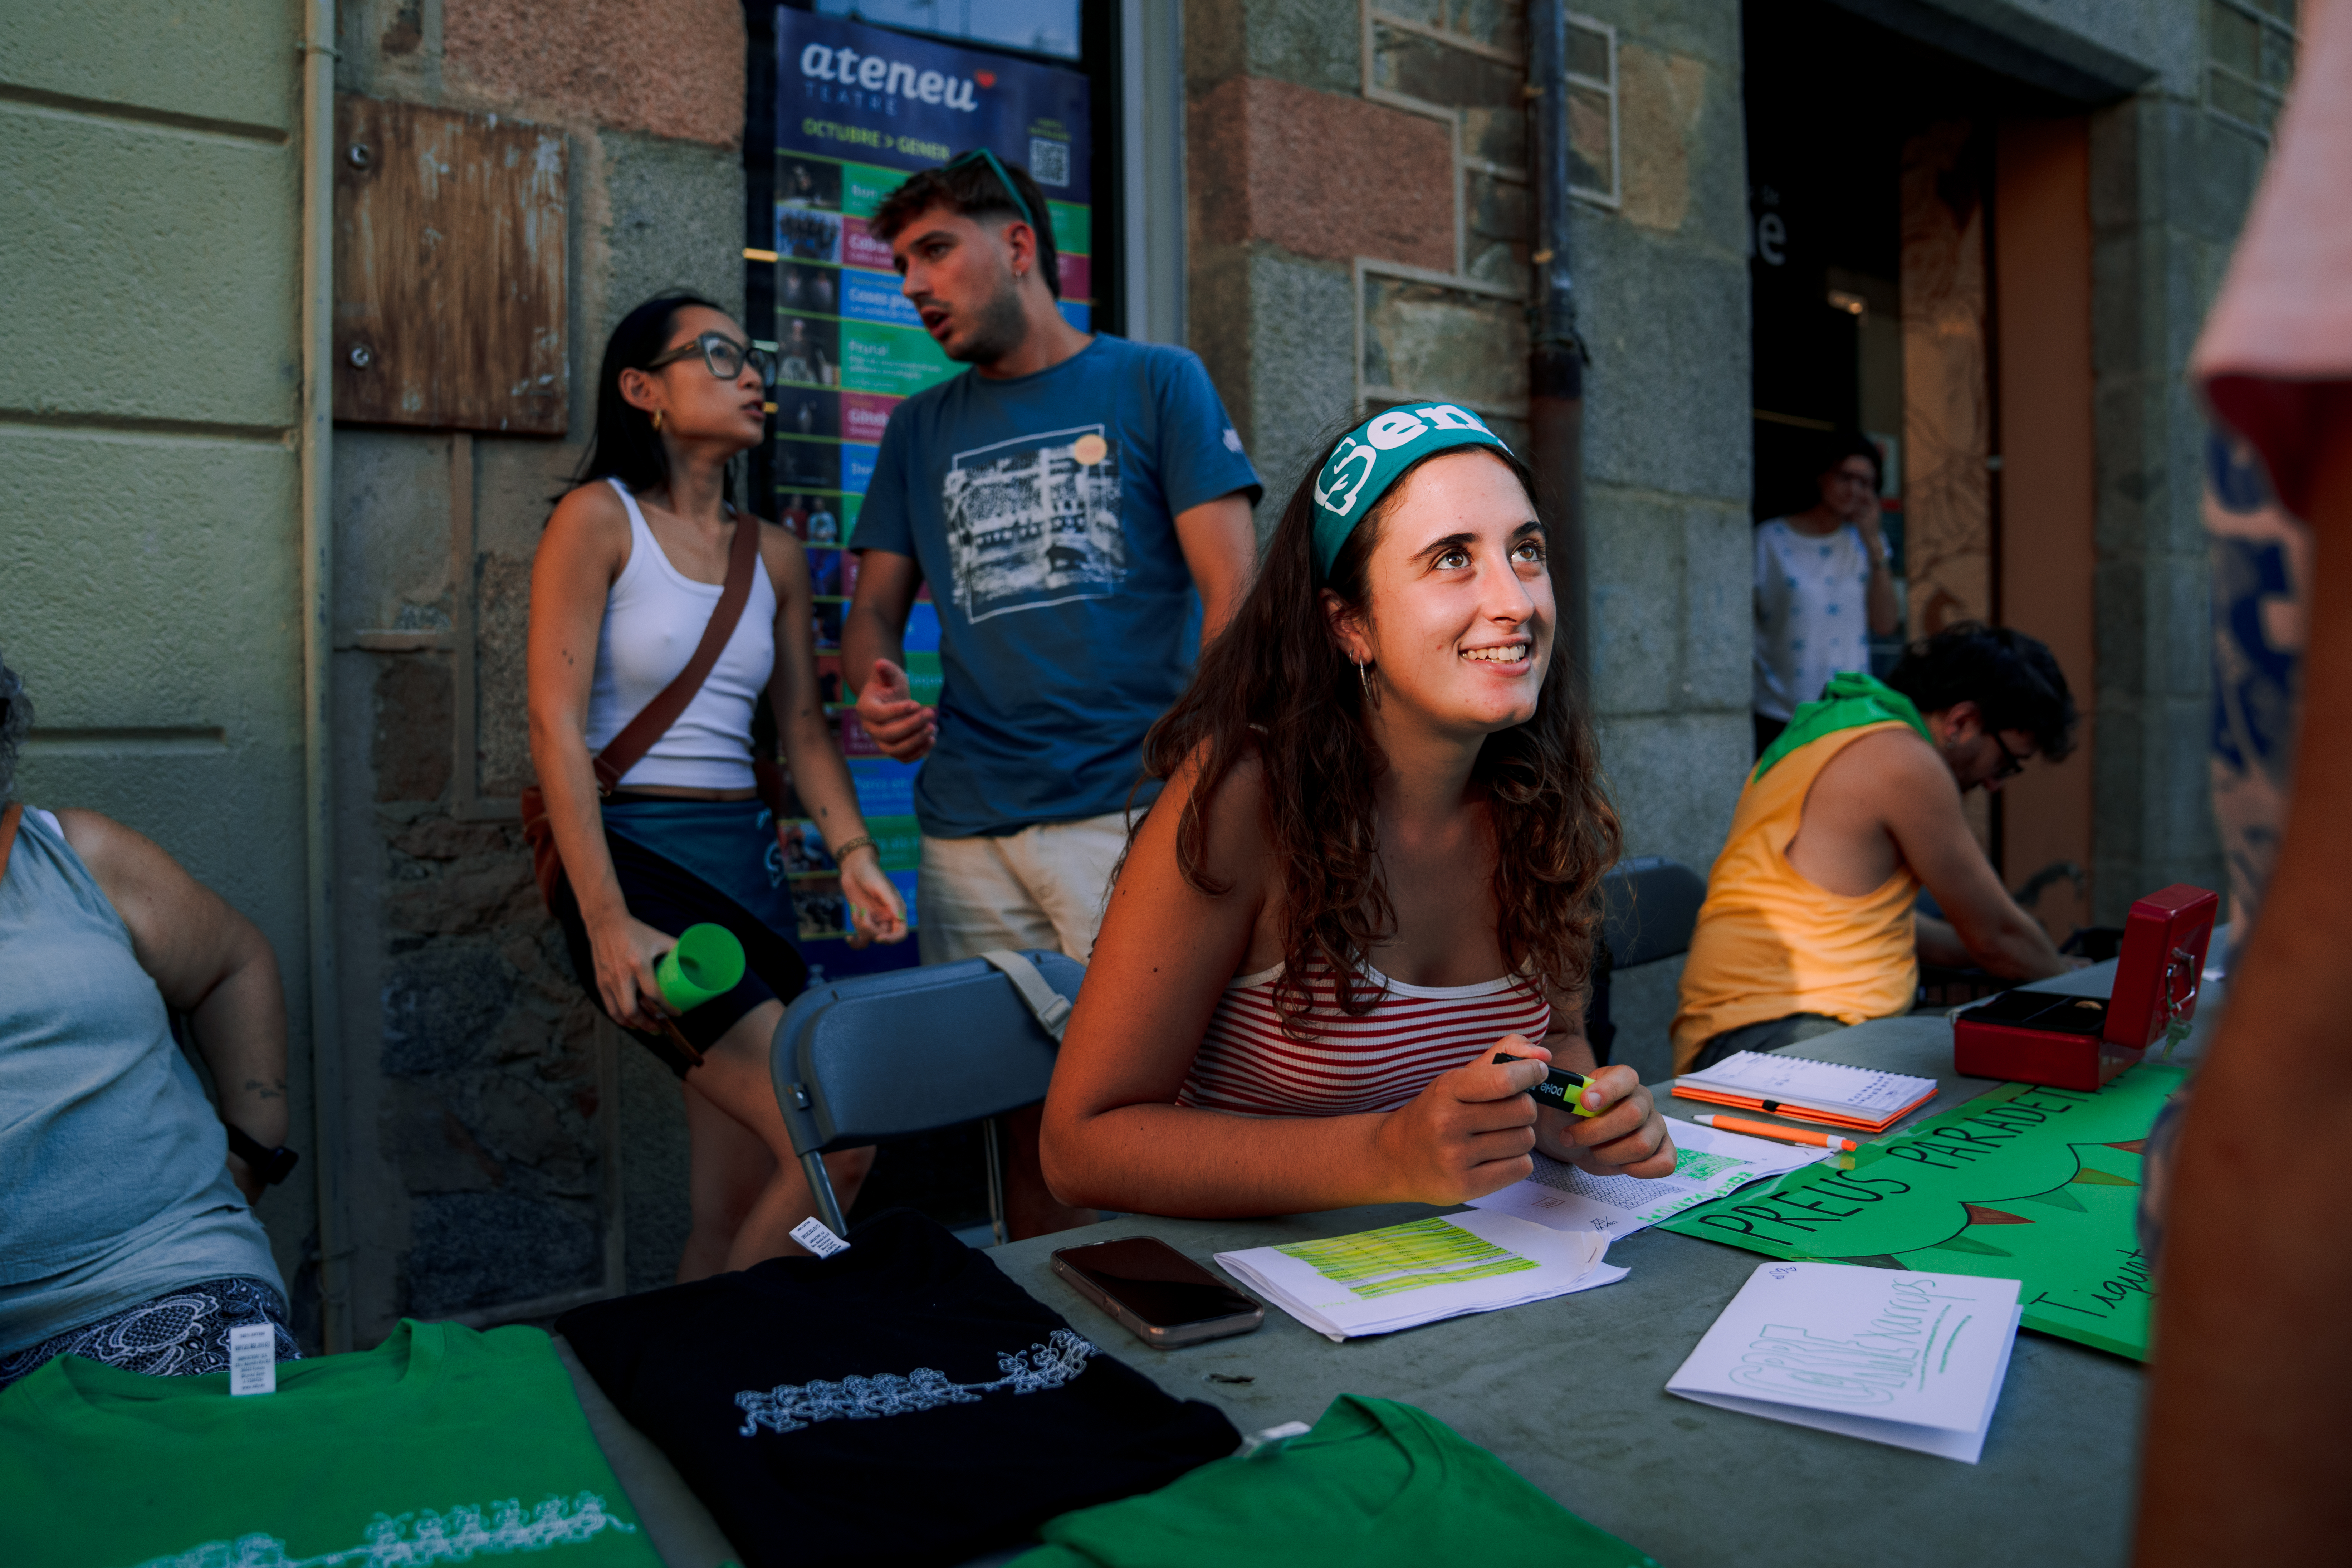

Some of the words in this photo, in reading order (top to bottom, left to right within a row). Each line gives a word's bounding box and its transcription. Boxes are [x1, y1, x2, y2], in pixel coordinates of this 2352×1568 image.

[800, 43, 978, 111] ateneu
[805, 80, 898, 116] TEATRE
[802, 118, 880, 147] OCTUBRE
[1314, 405, 1515, 516] Sen
[1698, 1169, 1911, 1245] PREUS
[1886, 1080, 2114, 1169] PARADET
